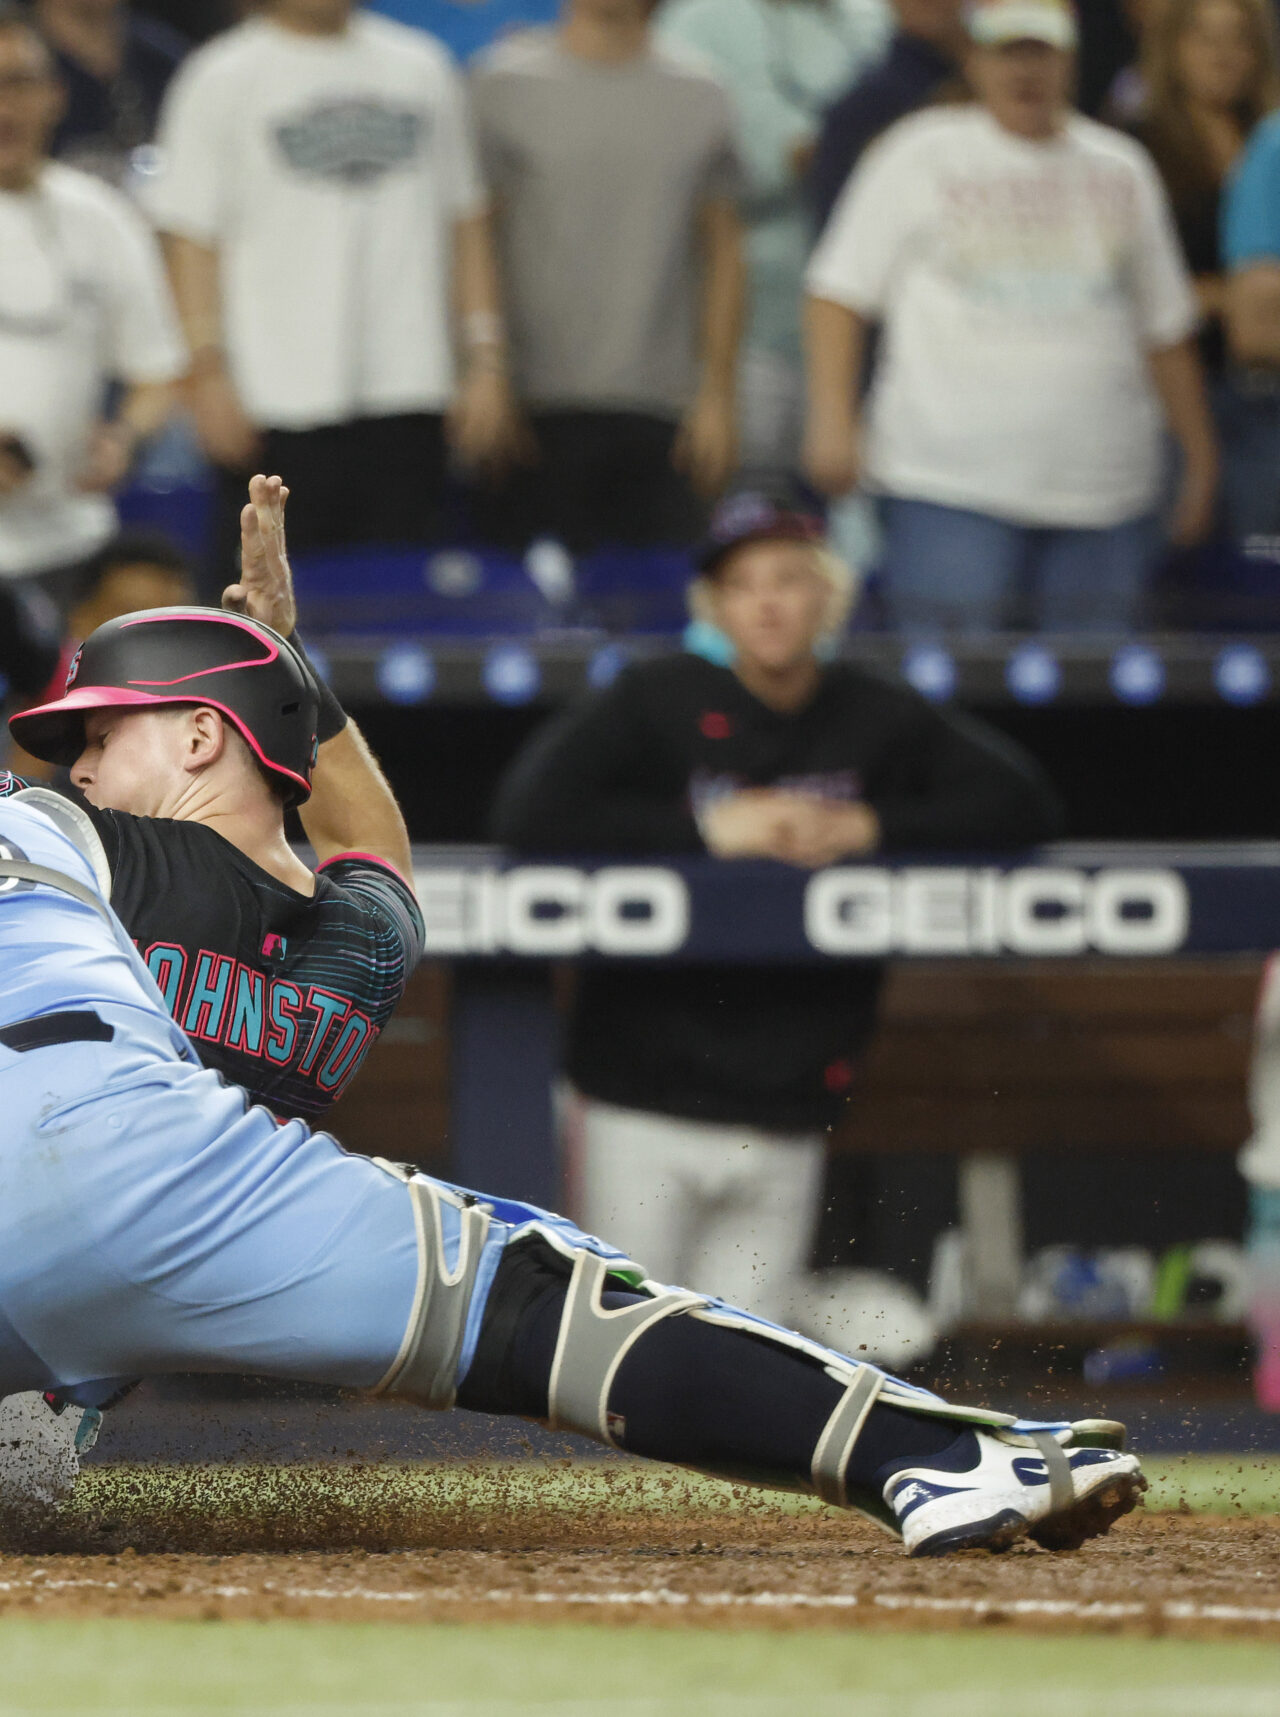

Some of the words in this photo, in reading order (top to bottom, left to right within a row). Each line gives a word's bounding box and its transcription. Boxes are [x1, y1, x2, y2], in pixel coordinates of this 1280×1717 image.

[412, 866, 690, 954] EICO
[803, 866, 1190, 955] GEICO
[131, 939, 381, 1101] OHNSTO
